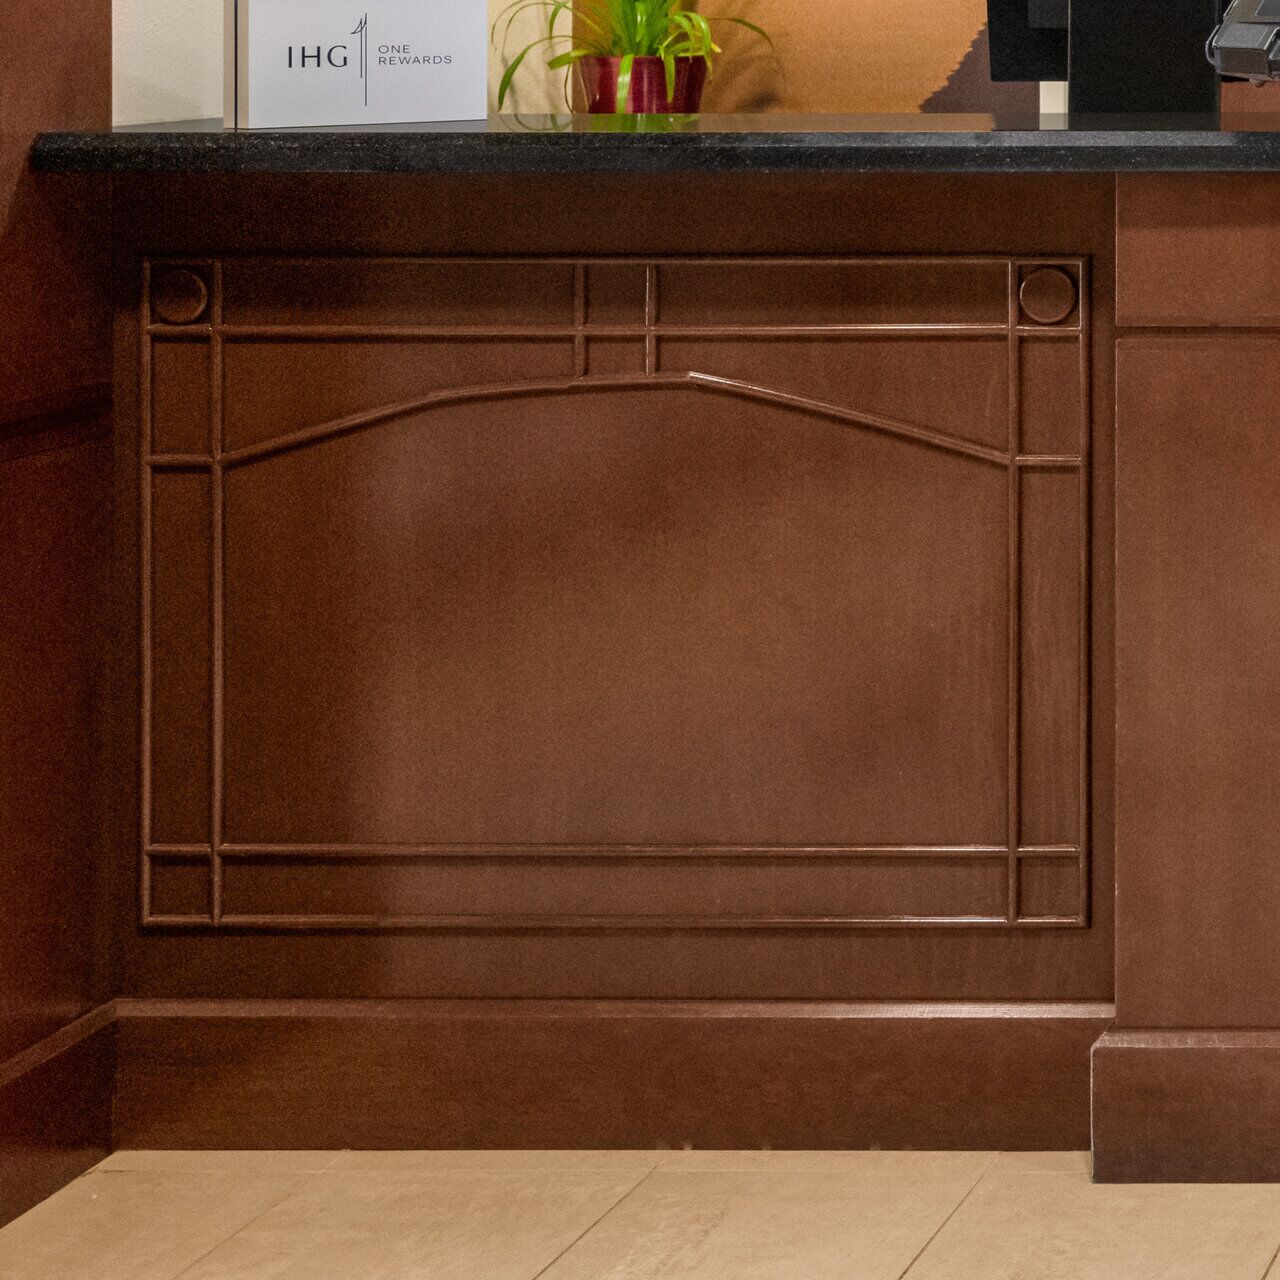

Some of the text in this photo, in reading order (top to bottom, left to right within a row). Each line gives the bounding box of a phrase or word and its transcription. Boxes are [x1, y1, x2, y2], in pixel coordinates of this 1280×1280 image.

[378, 44, 411, 54] ONE
[287, 45, 348, 68] IHG
[378, 55, 453, 66] REWARDS
